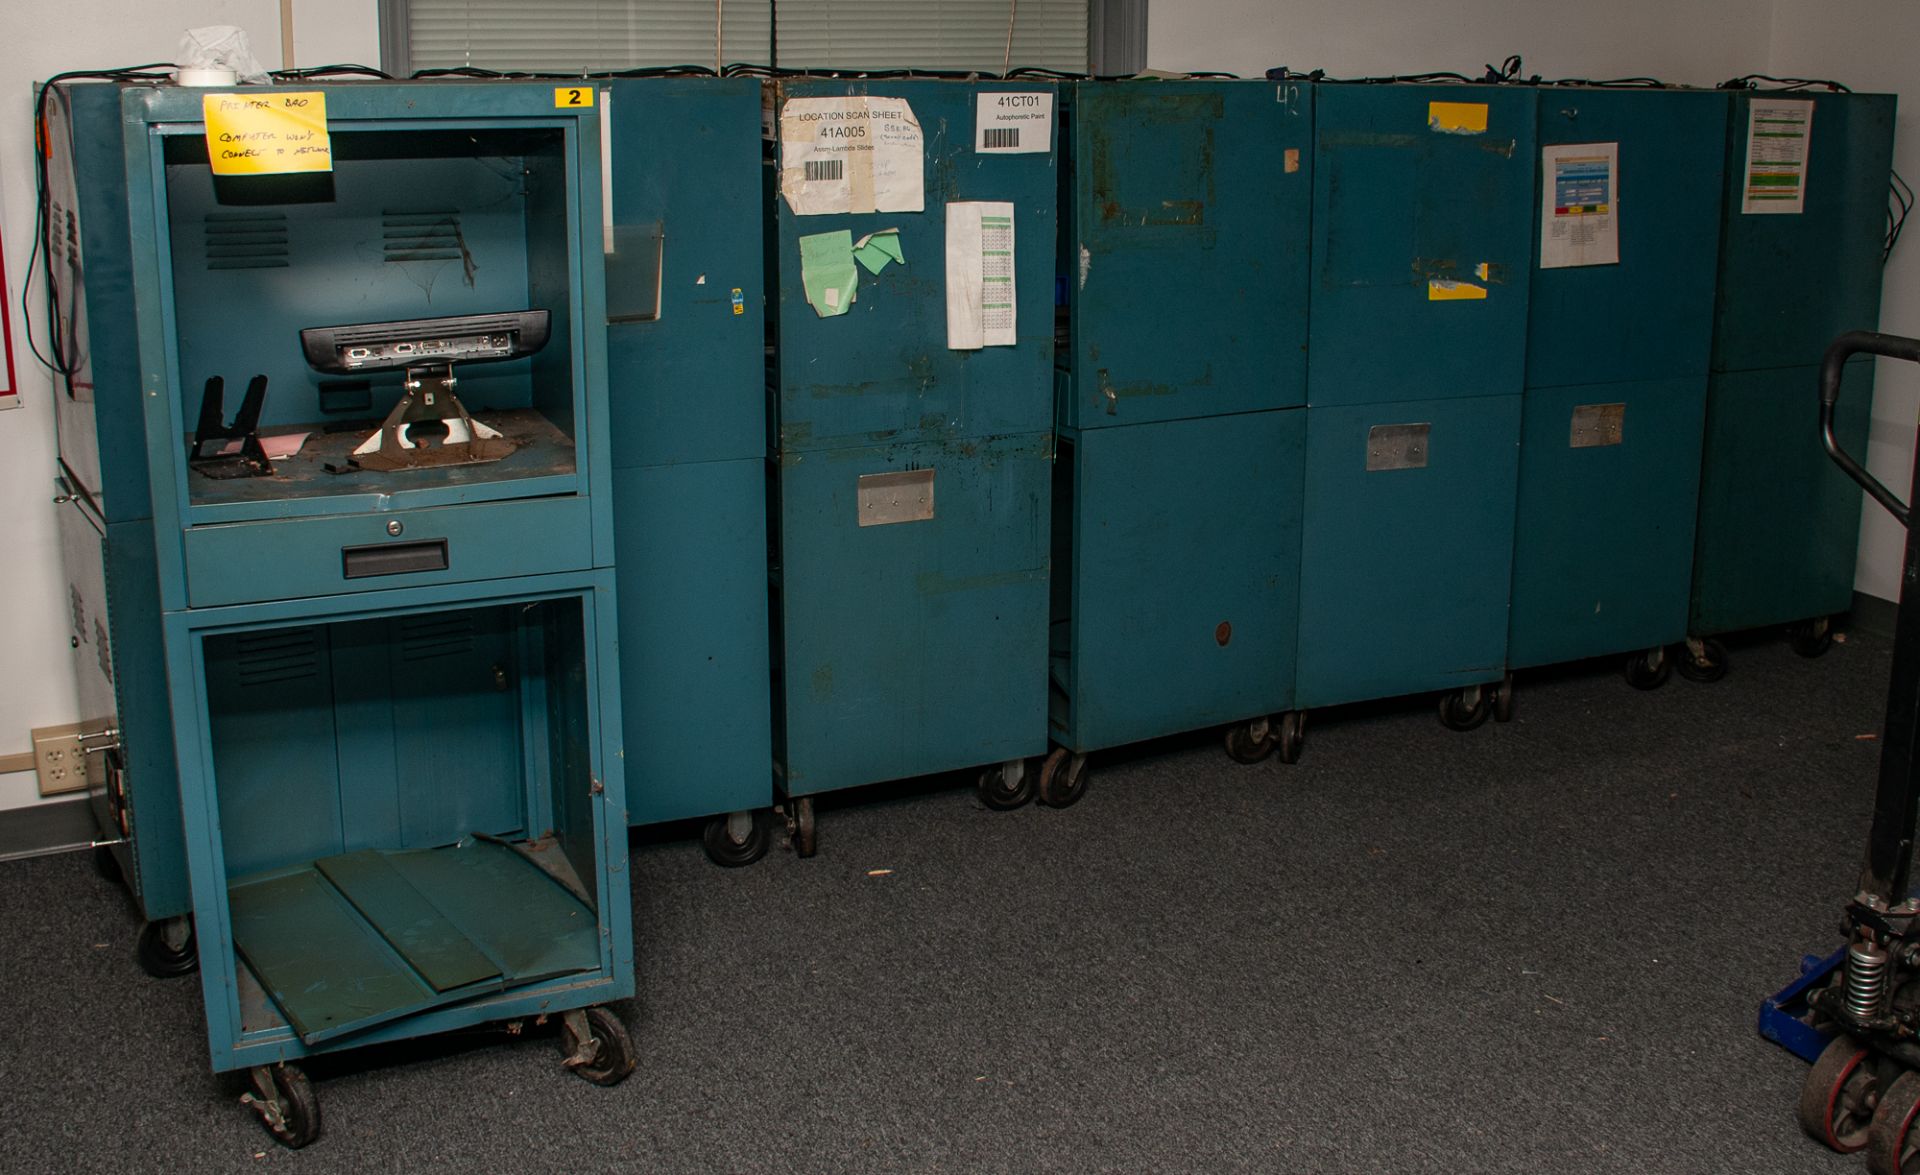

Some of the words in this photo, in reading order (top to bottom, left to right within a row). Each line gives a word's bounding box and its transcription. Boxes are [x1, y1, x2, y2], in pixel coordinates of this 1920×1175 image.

[569, 90, 581, 104] 2
[998, 96, 1040, 107] 41CT01
[220, 99, 270, 112] PRINTER
[285, 98, 308, 108] BAD
[799, 112, 844, 121] LOCATION
[846, 112, 870, 120] SCAN
[872, 111, 902, 119] SHEET
[219, 132, 277, 143] COMPUTER
[820, 126, 866, 139] 41A005
[221, 148, 267, 159] CONNECT
